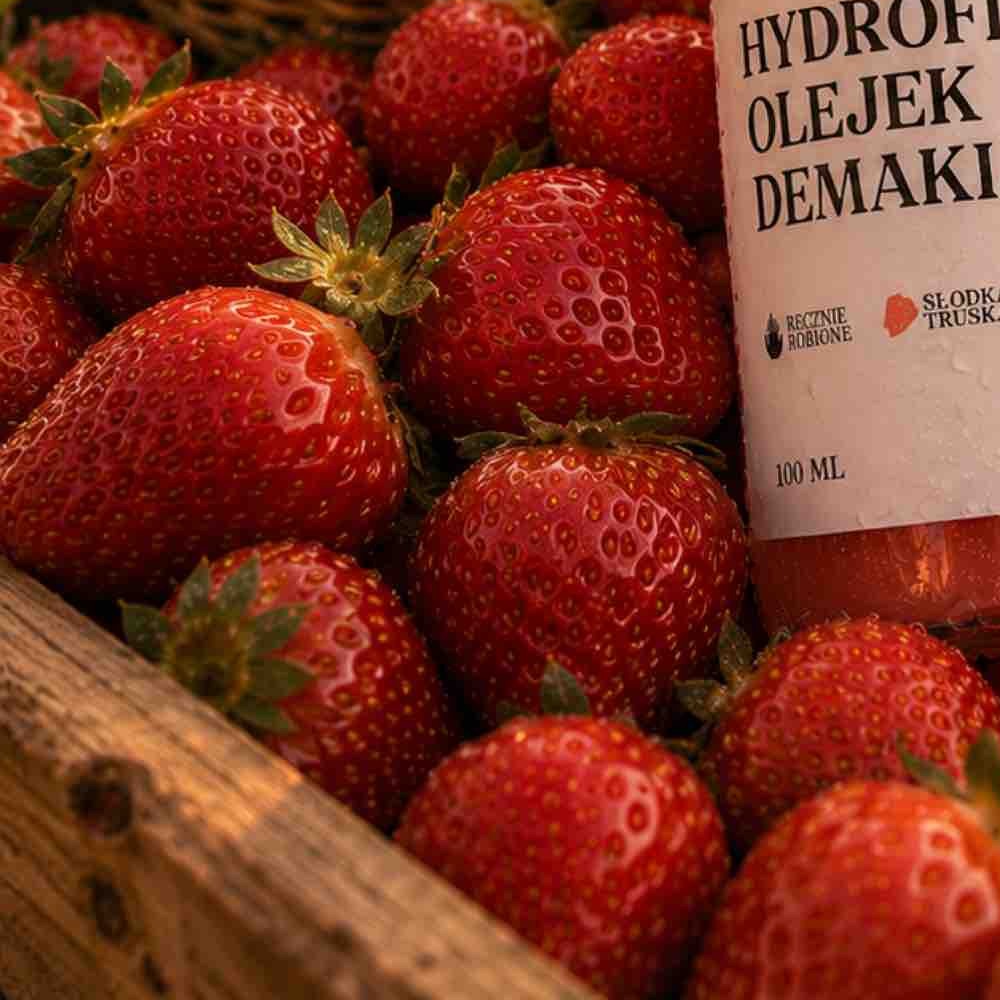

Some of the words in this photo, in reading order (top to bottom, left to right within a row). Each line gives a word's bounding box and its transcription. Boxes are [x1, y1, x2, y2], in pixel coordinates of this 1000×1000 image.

[748, 65, 983, 154] OLEJEK
[787, 325, 853, 352] ROBIONE
[775, 460, 804, 489] 100
[809, 455, 846, 484] ML
